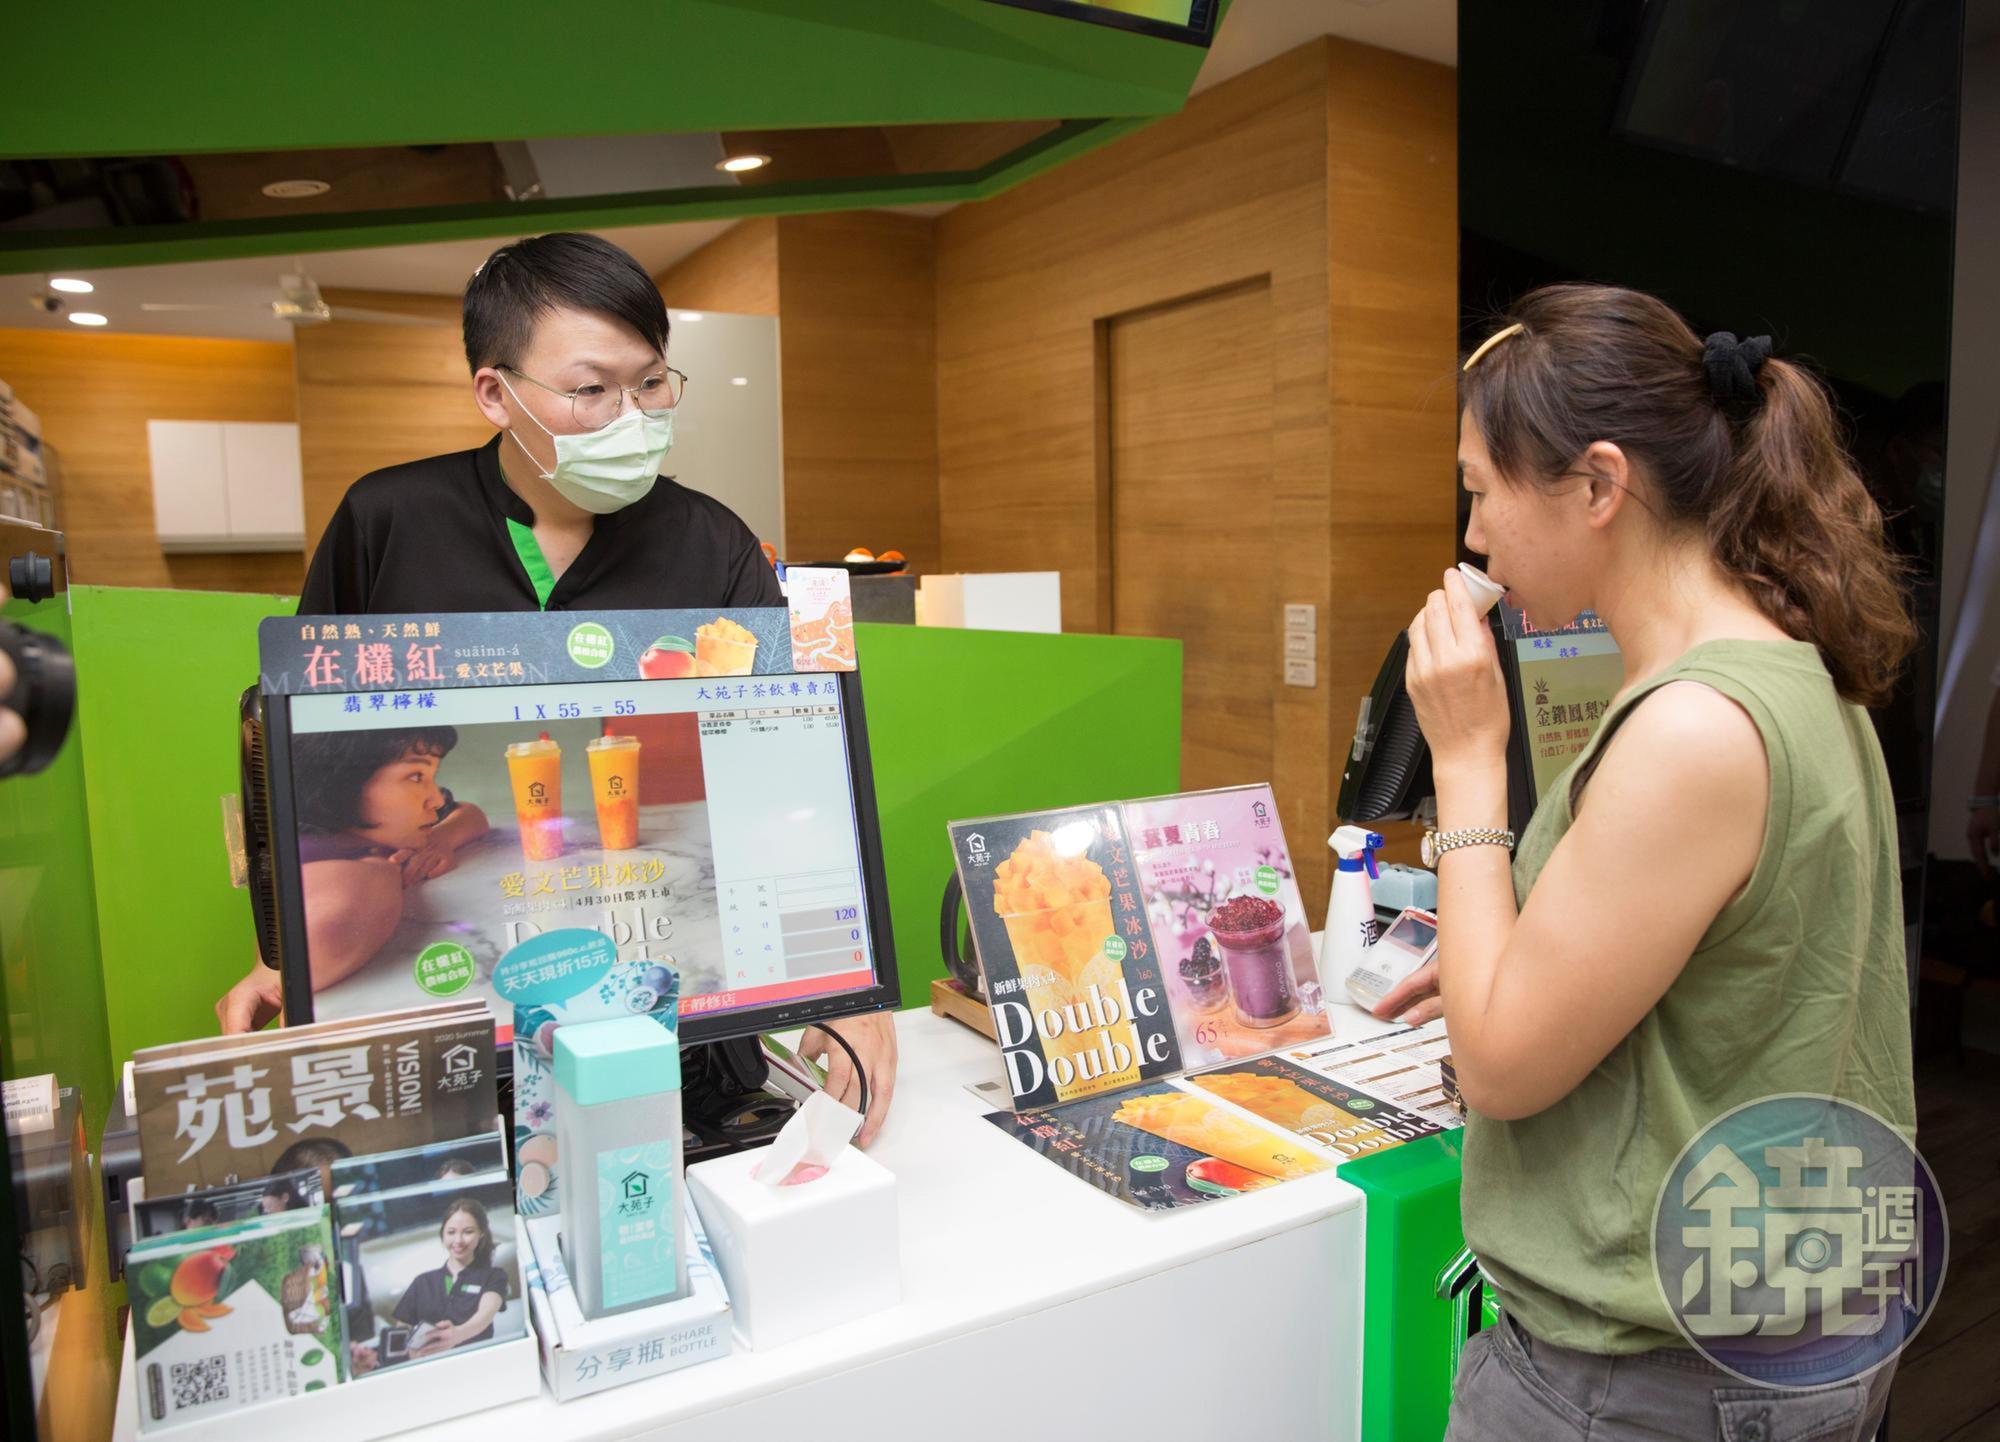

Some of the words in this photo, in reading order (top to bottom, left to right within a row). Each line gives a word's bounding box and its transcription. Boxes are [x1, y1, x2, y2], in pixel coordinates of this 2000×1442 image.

[301, 622, 441, 641] 自然熟、天然鮮
[456, 662, 524, 679] 愛文芒果
[696, 681, 836, 700] 大苑子茶飲專賣店
[344, 692, 439, 713] 翡翠檸檬
[559, 703, 580, 718] 55
[615, 700, 636, 715] 55
[967, 852, 992, 864] 大苑子
[500, 859, 665, 899] 愛文芒果冰沙
[835, 908, 856, 921] 120
[503, 907, 674, 946] Dble
[851, 929, 859, 941] 0
[854, 951, 862, 962] 0
[504, 950, 609, 994] 天天現折15元
[991, 978, 1159, 1049] Double
[1196, 1021, 1218, 1044] 65
[1003, 1022, 1170, 1097] Double
[396, 1040, 422, 1110] VISION
[438, 1070, 483, 1090] 大苑子
[165, 1045, 381, 1165] 苑景
[1306, 1110, 1417, 1146] Double
[1324, 1120, 1441, 1161] Double
[618, 1196, 654, 1214] 大苑子
[671, 1324, 713, 1344] SHARE
[670, 1336, 718, 1357] BOTTLE
[576, 1337, 665, 1382] 分享瓶
